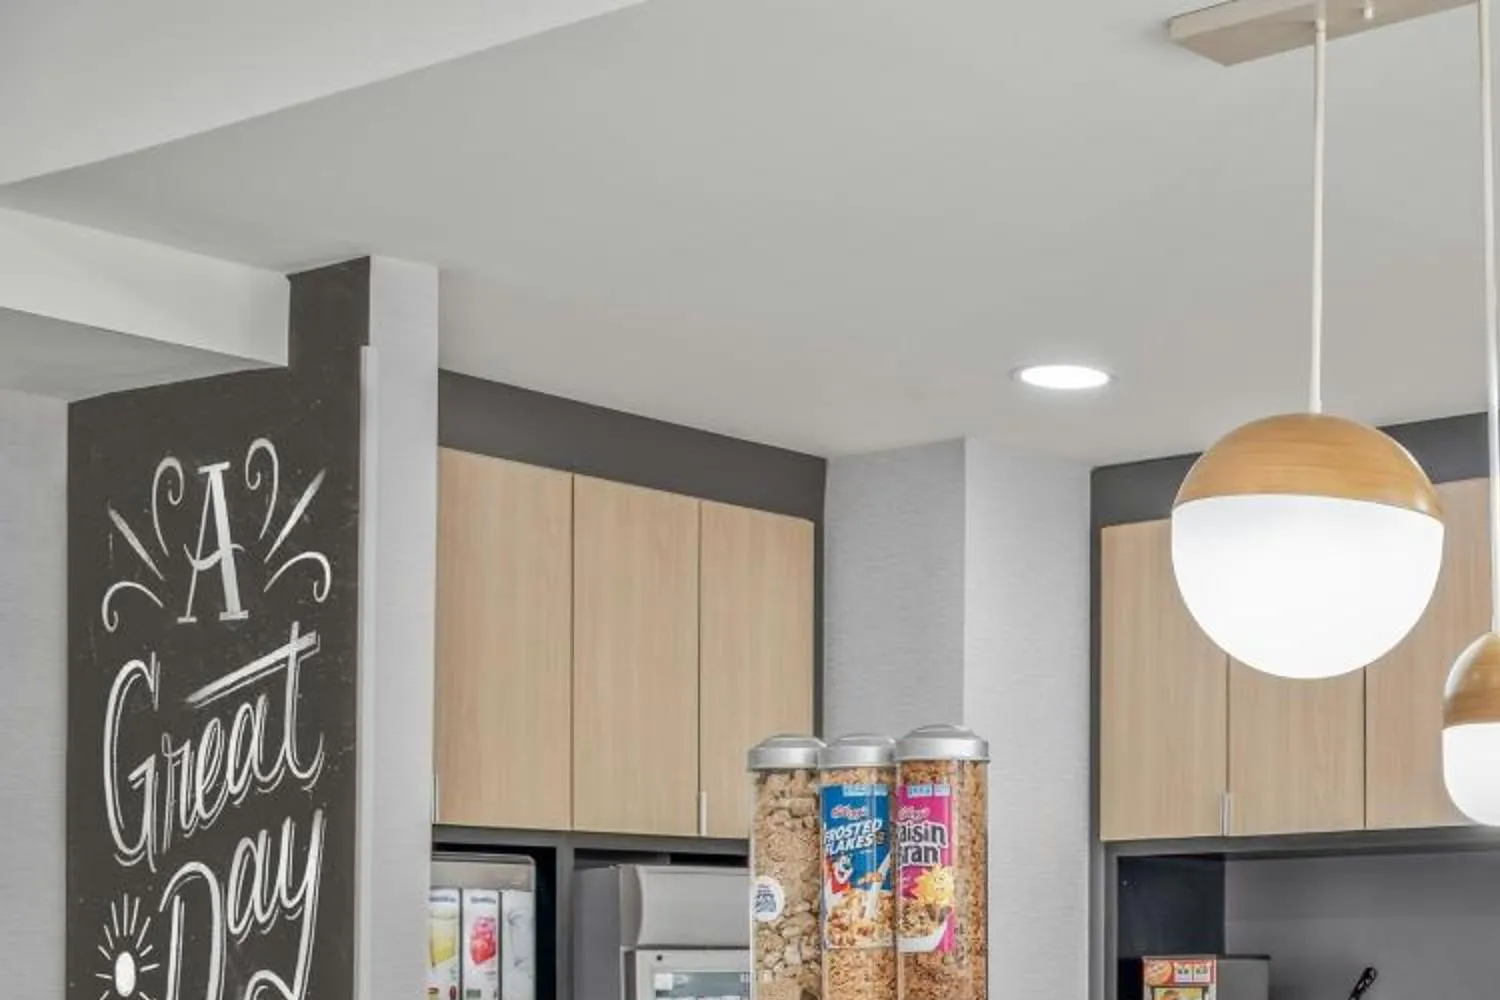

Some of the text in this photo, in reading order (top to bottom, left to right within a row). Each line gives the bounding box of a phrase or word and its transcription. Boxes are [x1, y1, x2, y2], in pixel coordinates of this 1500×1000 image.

[176, 460, 249, 624] A
[103, 620, 324, 872] Great
[898, 822, 947, 846] aisin
